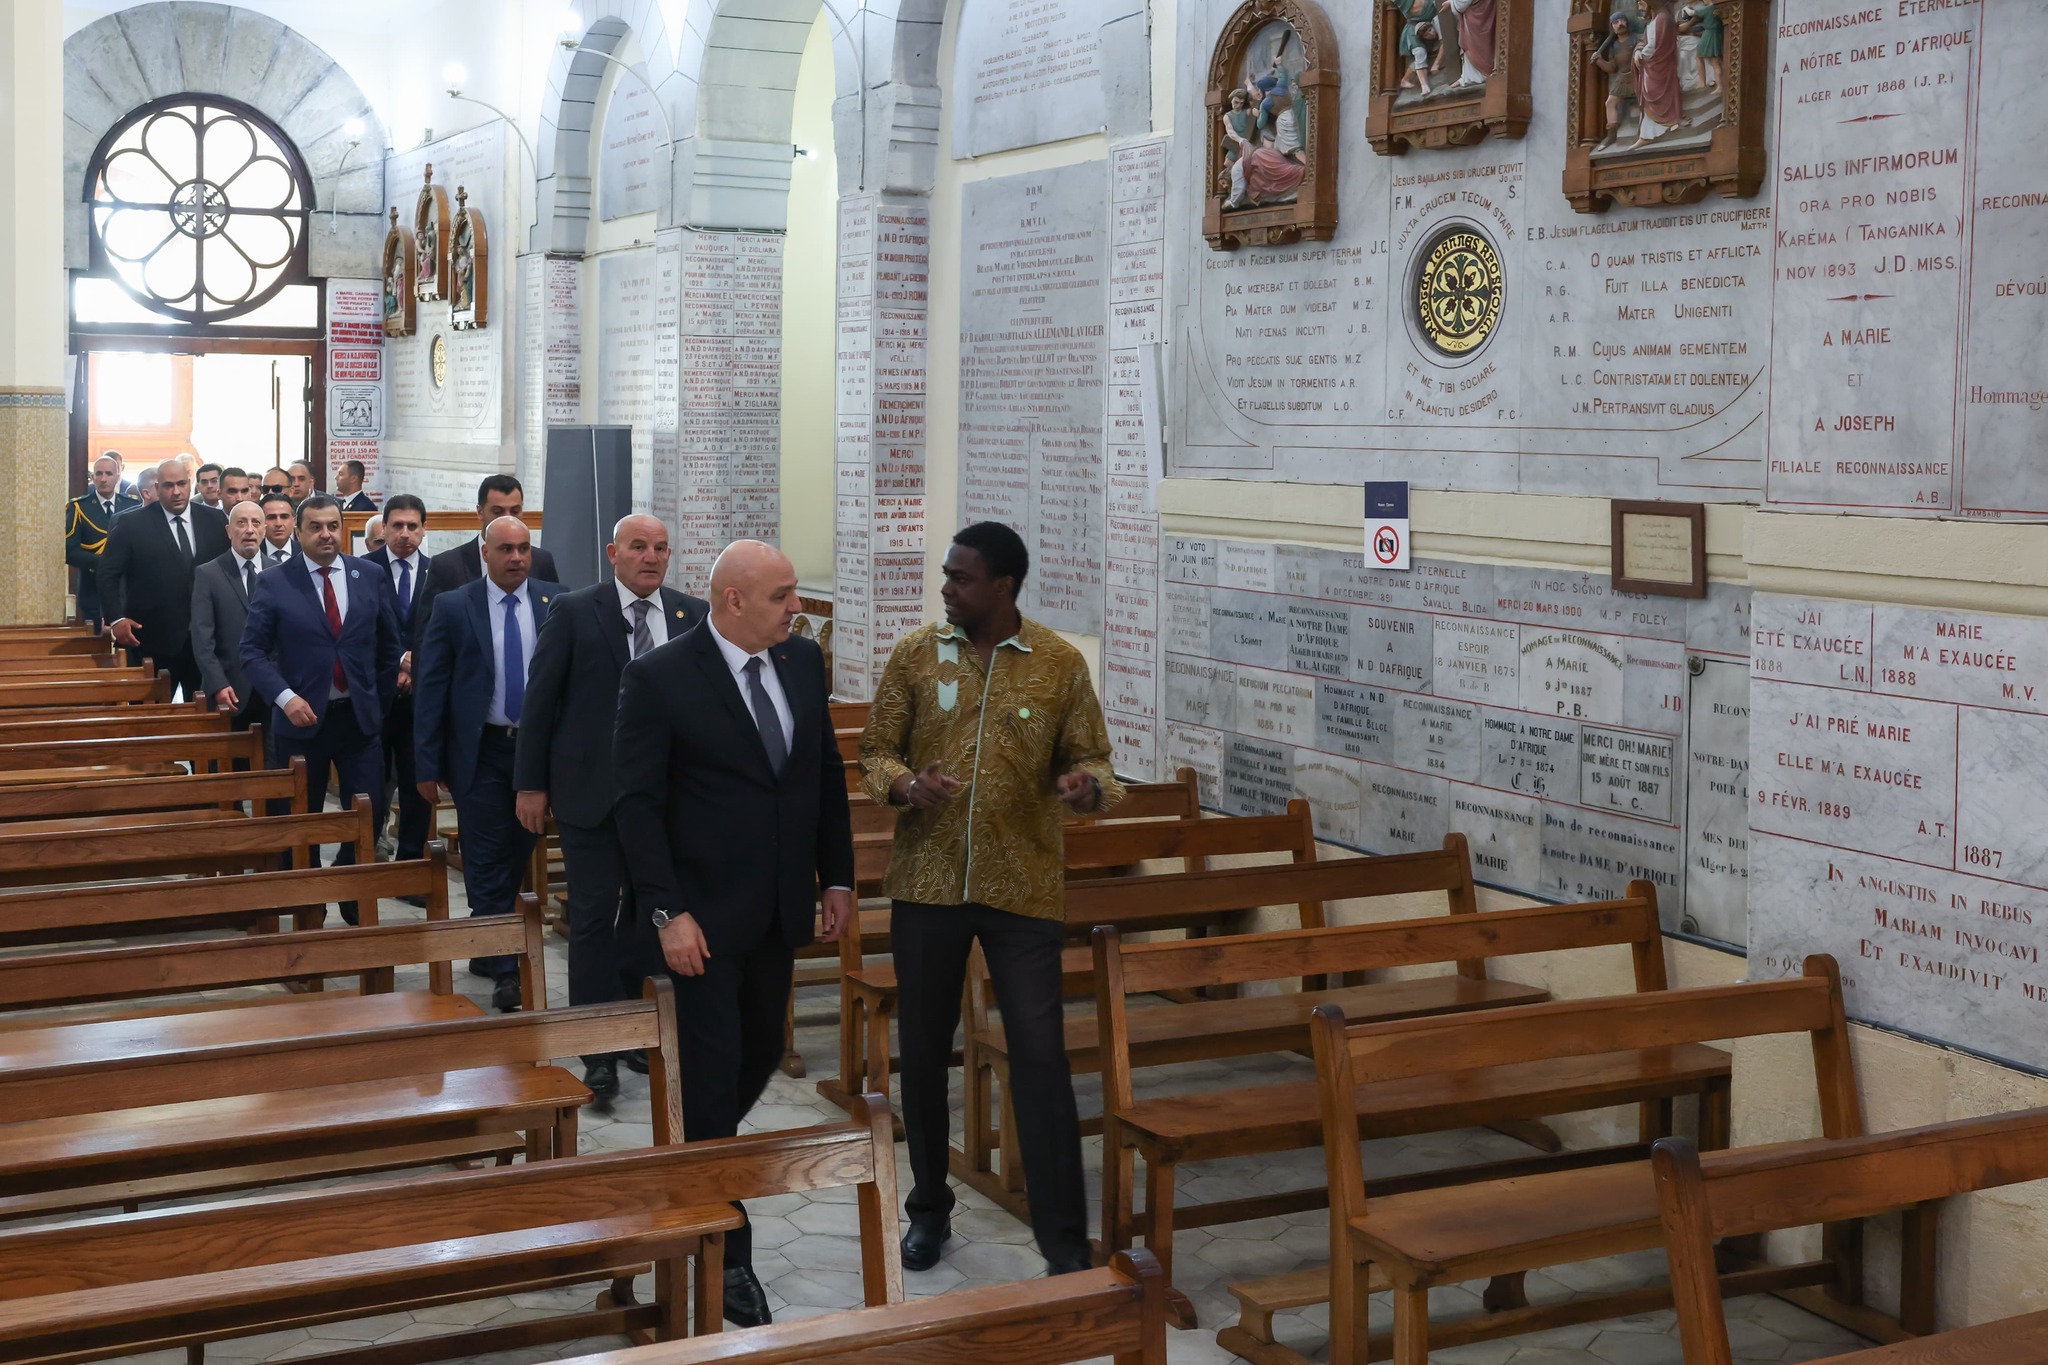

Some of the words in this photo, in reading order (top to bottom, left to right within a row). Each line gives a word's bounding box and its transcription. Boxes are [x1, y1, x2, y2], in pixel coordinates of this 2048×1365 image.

[1778, 9, 1882, 39] RECONNAISSANCE
[1782, 63, 1790, 73] A
[1850, 45, 1886, 63] DAME
[1896, 29, 1973, 56] D'AFRIQUE
[1798, 91, 1832, 104] ALGER
[1841, 85, 1870, 98] AOUT
[1877, 80, 1906, 94] 1888
[1453, 169, 1466, 179] SIBI
[1468, 166, 1496, 178] CRUCEM
[1499, 163, 1523, 175] EXIVIT
[1784, 162, 1837, 182] SALUS
[1845, 148, 1958, 176] INFIRMORUM
[1799, 200, 1831, 213] ORA
[1841, 195, 1875, 209] PRO
[1887, 188, 1938, 204] NOBIS
[1420, 192, 1456, 217] CRUCEM
[1462, 192, 1491, 210] TECUM
[1493, 207, 1516, 241] STARE
[1580, 220, 1638, 236] FLAGELLATUM
[1640, 216, 1677, 230] TRADIDIT
[1680, 215, 1694, 227] EIS
[1696, 214, 1708, 225] UT
[1711, 207, 1771, 224] CRUCIFIGERE
[1279, 252, 1298, 263] SUAM
[1302, 251, 1327, 261] SUPER
[1591, 253, 1600, 268] O
[1607, 255, 1635, 269] QUAM
[1642, 251, 1683, 264] TRISTIS
[1689, 249, 1702, 260] ET
[1707, 245, 1761, 259] AFFLICTA
[1787, 267, 1816, 279] NOV
[1823, 263, 1857, 277] 1893
[1642, 281, 1668, 292] ILLA
[1682, 276, 1745, 290] BENEDICTA
[1281, 305, 1297, 314] DUM
[1305, 302, 1337, 313] VIDEBAT
[1823, 332, 1833, 346] A
[1842, 328, 1891, 345] MARIE
[1633, 344, 1671, 356] ANIMAM
[1680, 343, 1747, 356] GEMENTEM
[1247, 356, 1280, 365] PECCATIS
[1309, 354, 1337, 365] GENTIS
[1278, 379, 1285, 387] IN
[1291, 378, 1336, 388] TORMENTIS
[1421, 375, 1433, 389] ME
[1439, 382, 1455, 393] TIBI
[1460, 362, 1497, 391] SOCIARE
[1674, 374, 1687, 385] ET
[1690, 374, 1749, 386] DOLENTEM
[1848, 374, 1864, 387] ET
[1416, 396, 1455, 417] PLANCTU
[1460, 389, 1498, 416] DESIDERO
[1670, 403, 1715, 416] GLADIUS
[1815, 417, 1825, 432] A
[1834, 416, 1895, 432] JOSEPH
[1772, 461, 1821, 473] FILIALE
[1836, 462, 1948, 476] RECONNAISSANCE
[878, 498, 896, 506] MERCI
[904, 498, 922, 506] MARIE
[877, 525, 890, 533] MES
[898, 524, 924, 532] ENFANTS
[1177, 541, 1184, 550] EX
[1190, 542, 1205, 552] VOTO
[1182, 555, 1196, 565] JUIN
[1201, 556, 1215, 566] 1877
[1417, 566, 1467, 579] ETERNELLE
[1289, 606, 1348, 621] RECONNAISSANCE
[1462, 602, 1488, 614] BLIDA
[1798, 607, 1823, 626] J'AI
[1296, 619, 1322, 630] NOTRE
[1369, 618, 1415, 634] SOUVENIR
[1633, 612, 1668, 626] FOLEY
[1435, 620, 1515, 639] RECONNAISSANCE
[1937, 623, 1983, 640] MARIE
[1458, 642, 1489, 654] ESPOIR
[1756, 625, 1786, 647] ÉTÉ
[1793, 635, 1864, 655] EXAUCÉE
[1435, 657, 1443, 667] 18
[1448, 659, 1487, 674] JANVIER
[1494, 665, 1515, 677] 1875
[1755, 660, 1783, 673] 1888
[1904, 645, 1930, 662] M'A
[1940, 649, 2017, 671] EXAUCÉE
[1882, 669, 1916, 686] 1888
[1485, 718, 1516, 733] HOMMAGE
[1529, 726, 1552, 740] NOTRE
[1555, 731, 1574, 744] DAME
[1790, 712, 1820, 729] J'AI
[1828, 715, 1859, 735] PRIÉ
[1868, 723, 1911, 743] MARIE
[1511, 740, 1547, 757] D'AFRIQUE
[1584, 733, 1613, 750] MERCI
[1619, 739, 1635, 753] OH!
[1638, 743, 1672, 760] MARIE!
[1583, 753, 1596, 765] UNE
[1600, 754, 1620, 769] MÈRE
[1623, 760, 1632, 770] ET
[1635, 762, 1650, 774] SON
[1653, 765, 1670, 778] FILS
[1778, 752, 1813, 770] ELLE
[1822, 760, 1845, 777] M'A
[1854, 766, 1922, 789] EXAUCÉE
[1592, 772, 1602, 784] 15
[1638, 781, 1659, 796] 1887
[1456, 800, 1534, 826] RECONNAISSANCE
[1759, 791, 1765, 803] 9
[1772, 791, 1811, 813] FÉVR.
[1818, 801, 1851, 819] 1889
[1390, 827, 1416, 843] MARIE
[1588, 827, 1675, 854] reconnaissance
[1475, 852, 1508, 872] MARIE
[1964, 845, 2002, 869] 1887
[1580, 853, 1611, 871] DAME
[1617, 861, 1678, 887] D'AFRIQUE
[1857, 876, 1937, 904] ANGUSTIIS
[1951, 894, 1968, 909] IN
[1981, 901, 2033, 924] REBUS
[1955, 931, 2038, 963] INVOCAVI
[1900, 953, 2003, 990] EXAUDIVIT
